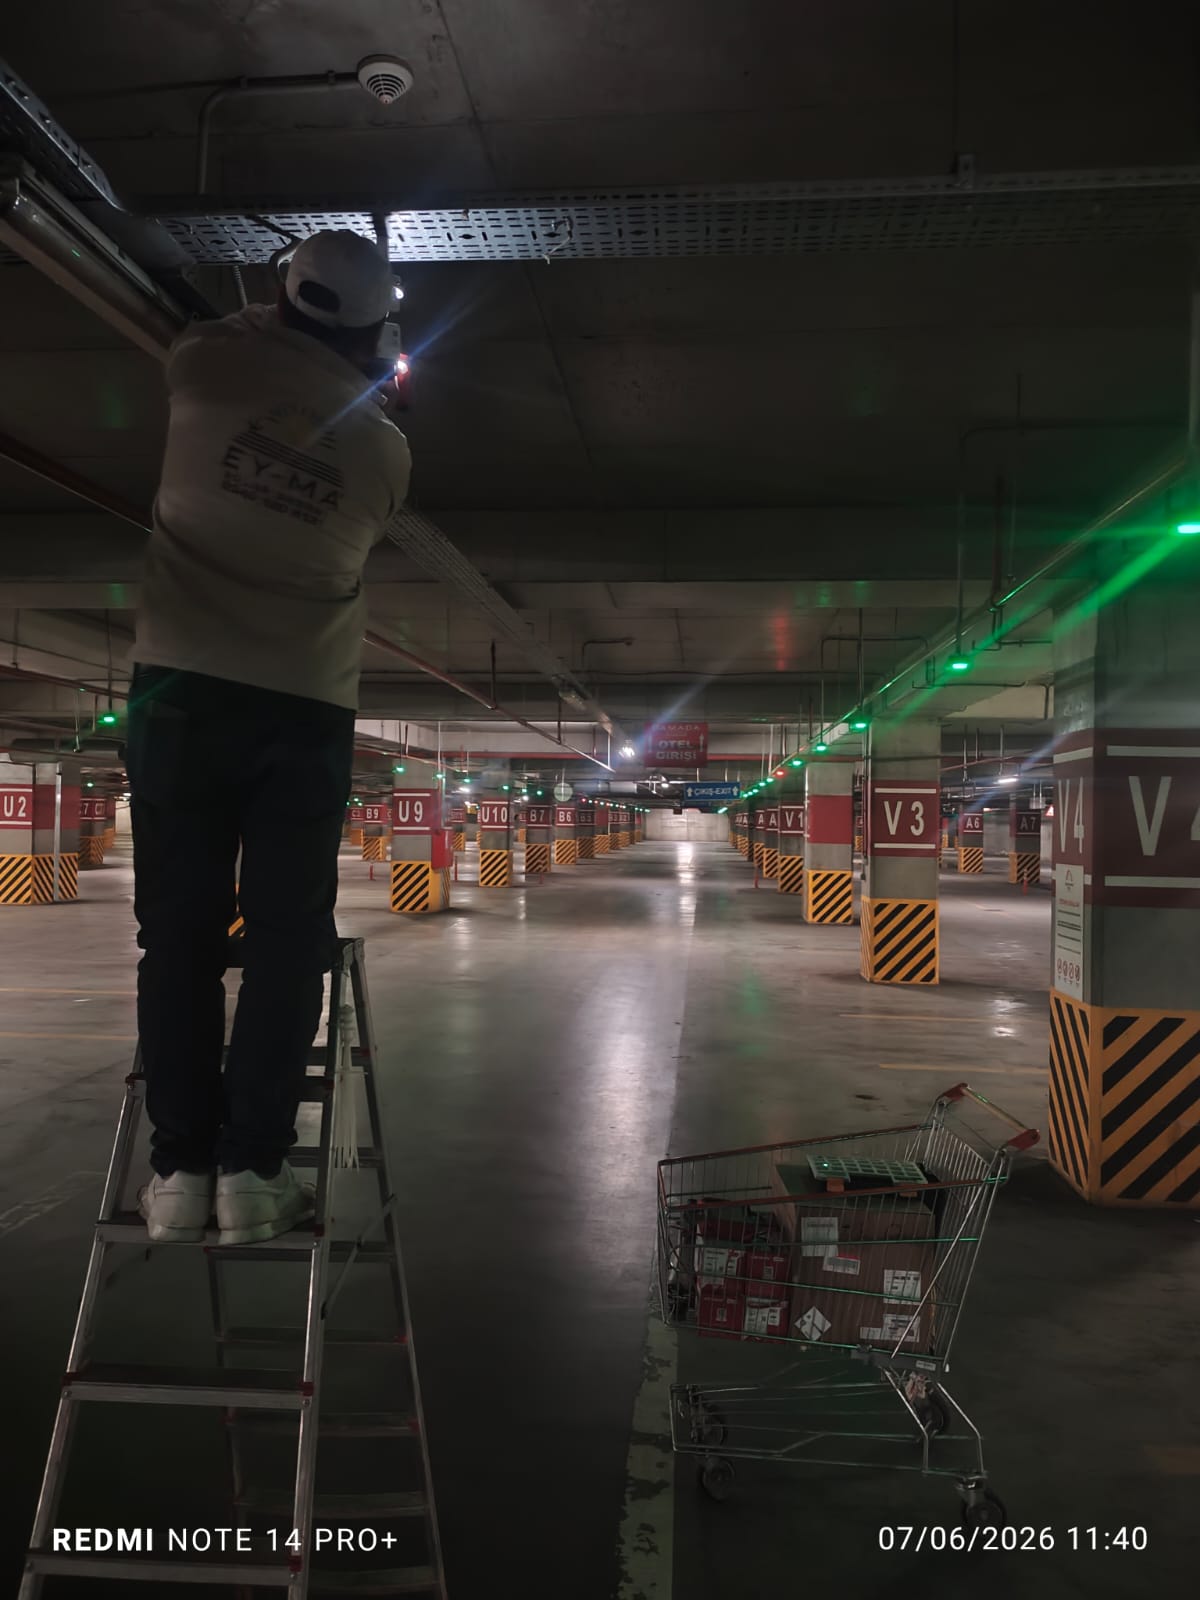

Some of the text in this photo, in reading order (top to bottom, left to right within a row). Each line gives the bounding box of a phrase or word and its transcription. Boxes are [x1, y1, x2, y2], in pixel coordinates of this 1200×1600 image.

[658, 740, 694, 750] OTEL
[398, 801, 423, 823] U9
[481, 807, 508, 823] U10
[883, 800, 925, 837] V3
